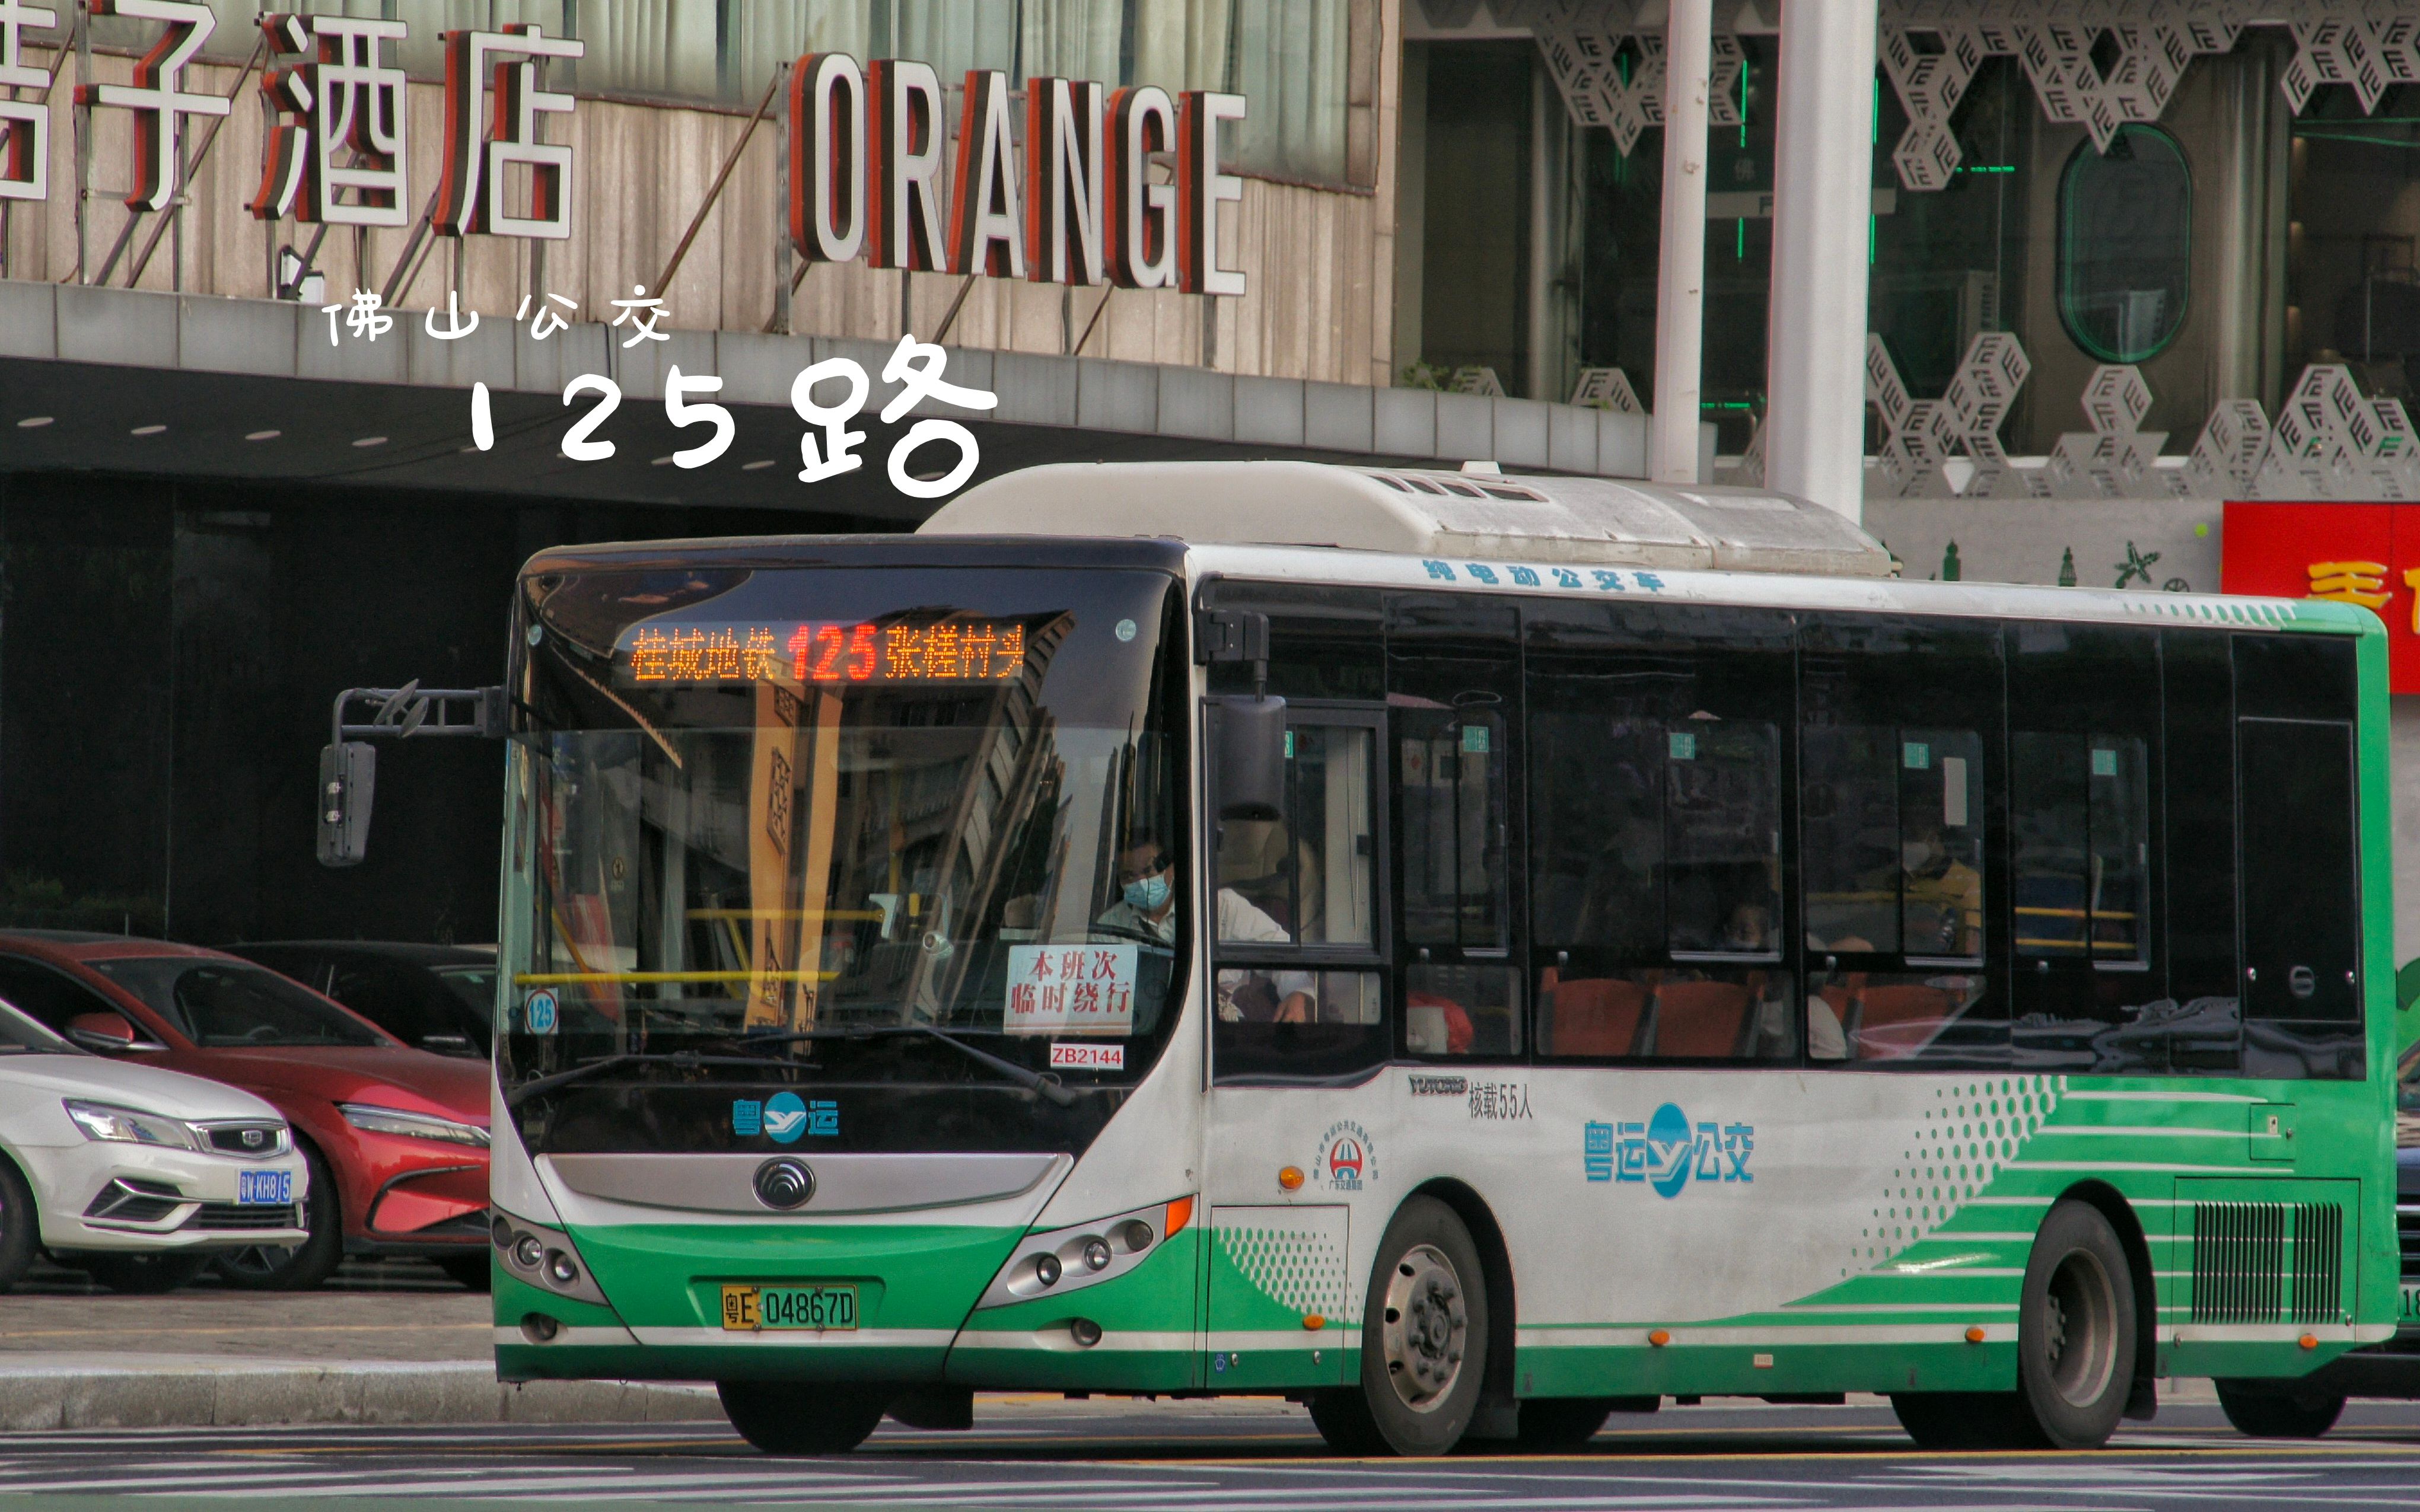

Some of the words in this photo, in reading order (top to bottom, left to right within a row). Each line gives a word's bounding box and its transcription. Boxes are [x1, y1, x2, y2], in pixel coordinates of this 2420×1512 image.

[791, 52, 1246, 296] ORANGE
[1422, 560, 1665, 592] 纯电动公交车
[631, 627, 775, 681] 桂城地铁
[788, 625, 877, 680] 125
[1028, 950, 1117, 981] 本班次
[1011, 982, 1130, 1013] 临时绕行
[529, 999, 552, 1028] 125
[1052, 1048, 1122, 1064] ZB2144
[1469, 1082, 1533, 1119] 核载55人
